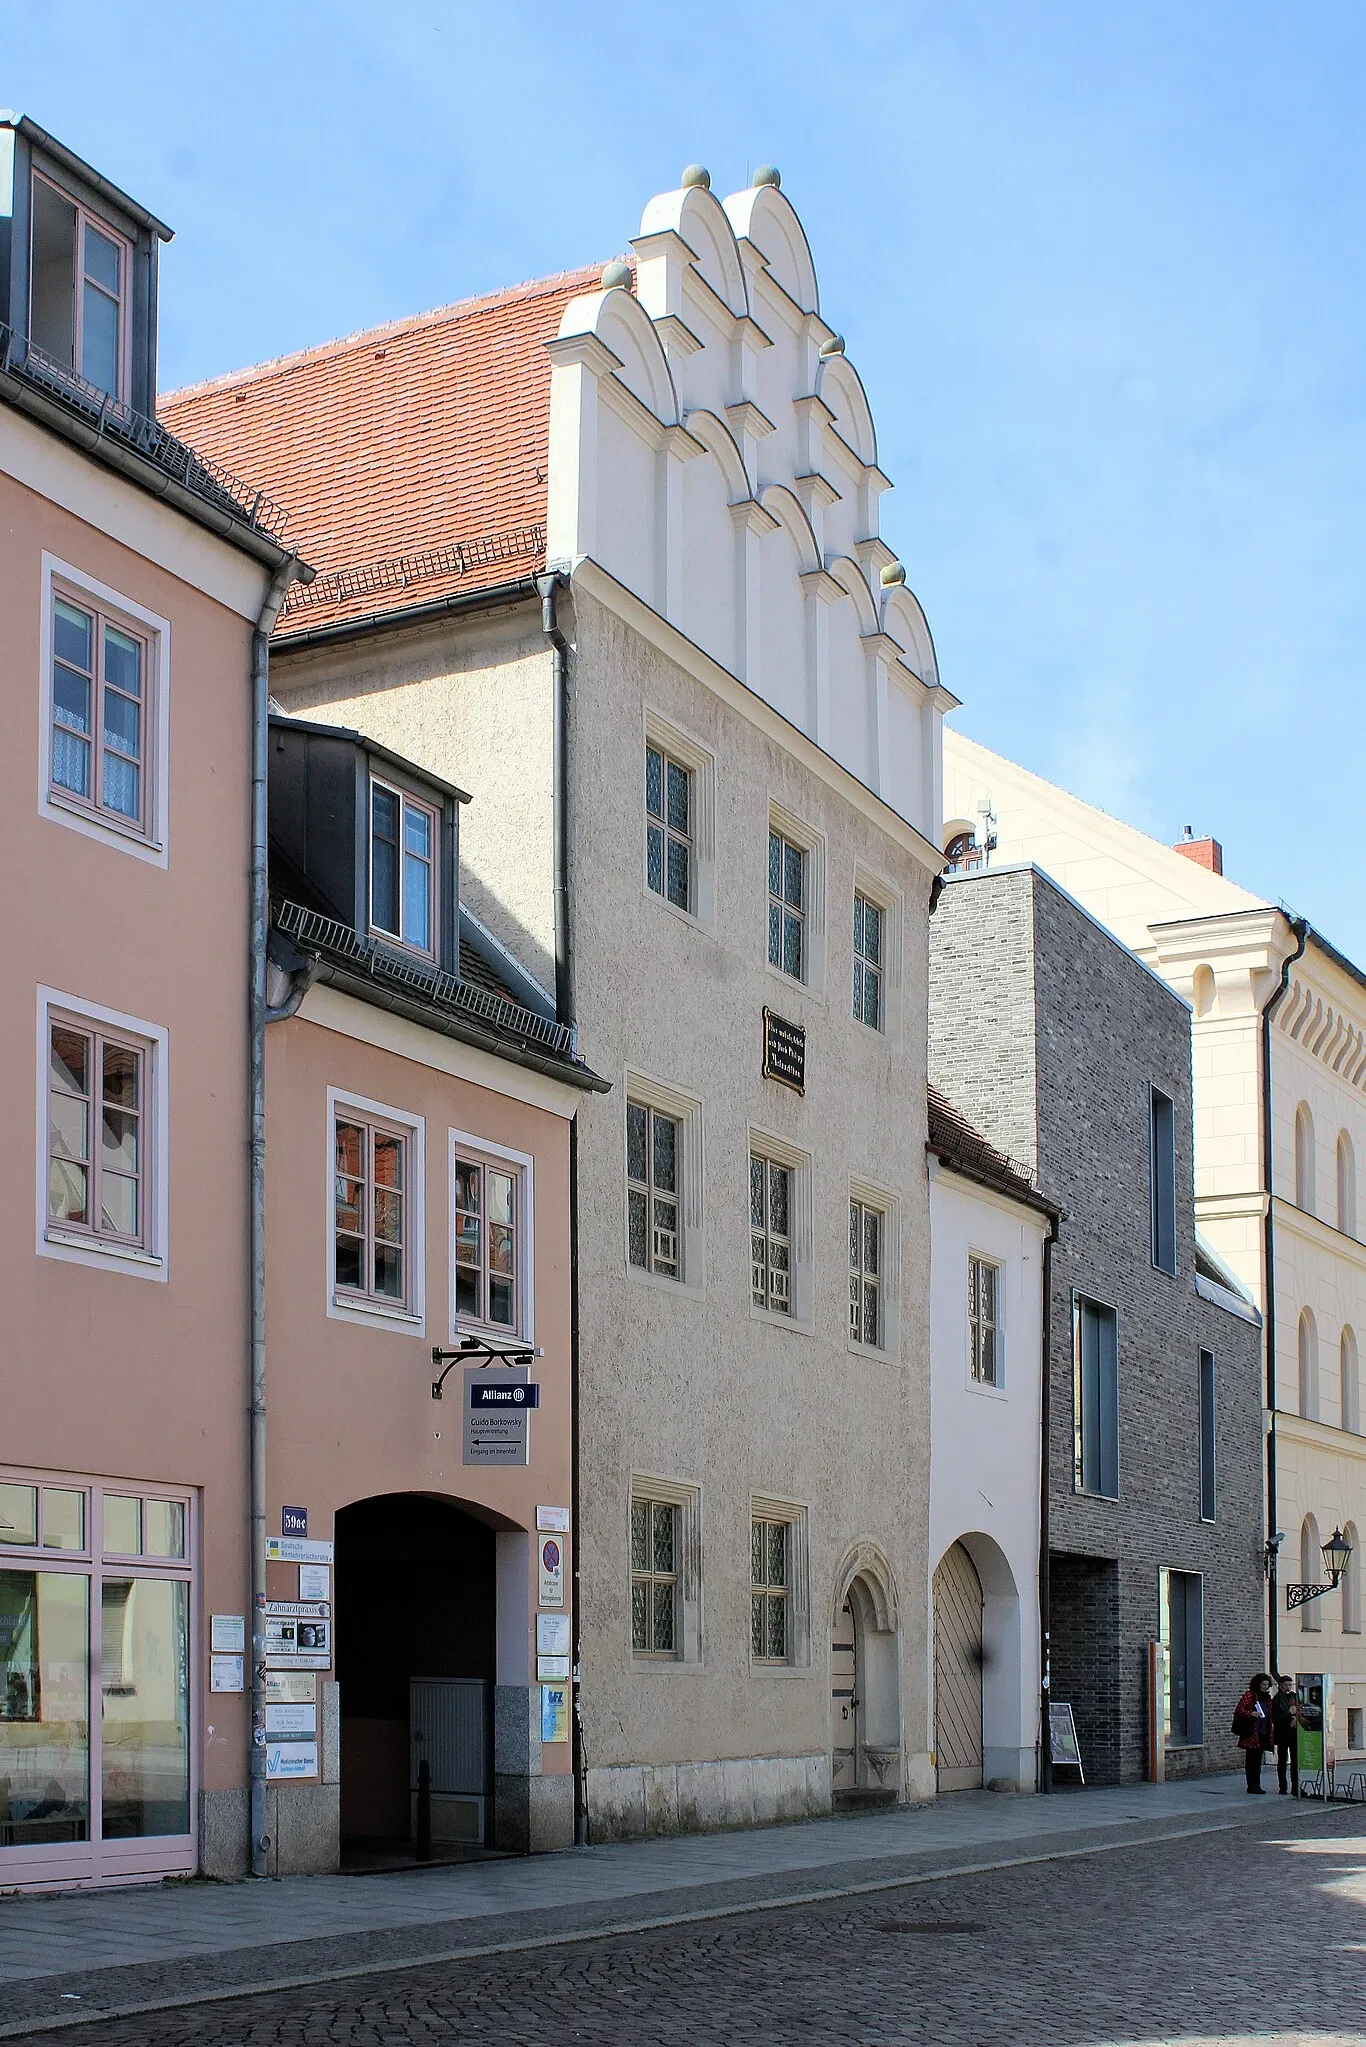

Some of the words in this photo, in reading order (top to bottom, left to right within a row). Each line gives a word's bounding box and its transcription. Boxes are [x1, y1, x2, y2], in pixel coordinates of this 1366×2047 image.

[482, 1390, 512, 1400] Allianz
[470, 1418, 489, 1426] Guido
[490, 1418, 522, 1427] Borkowsky
[281, 1541, 303, 1550] Deutsche
[281, 1550, 329, 1562] Rentenversicherung
[269, 1603, 318, 1615] Zahnarztpraxis
